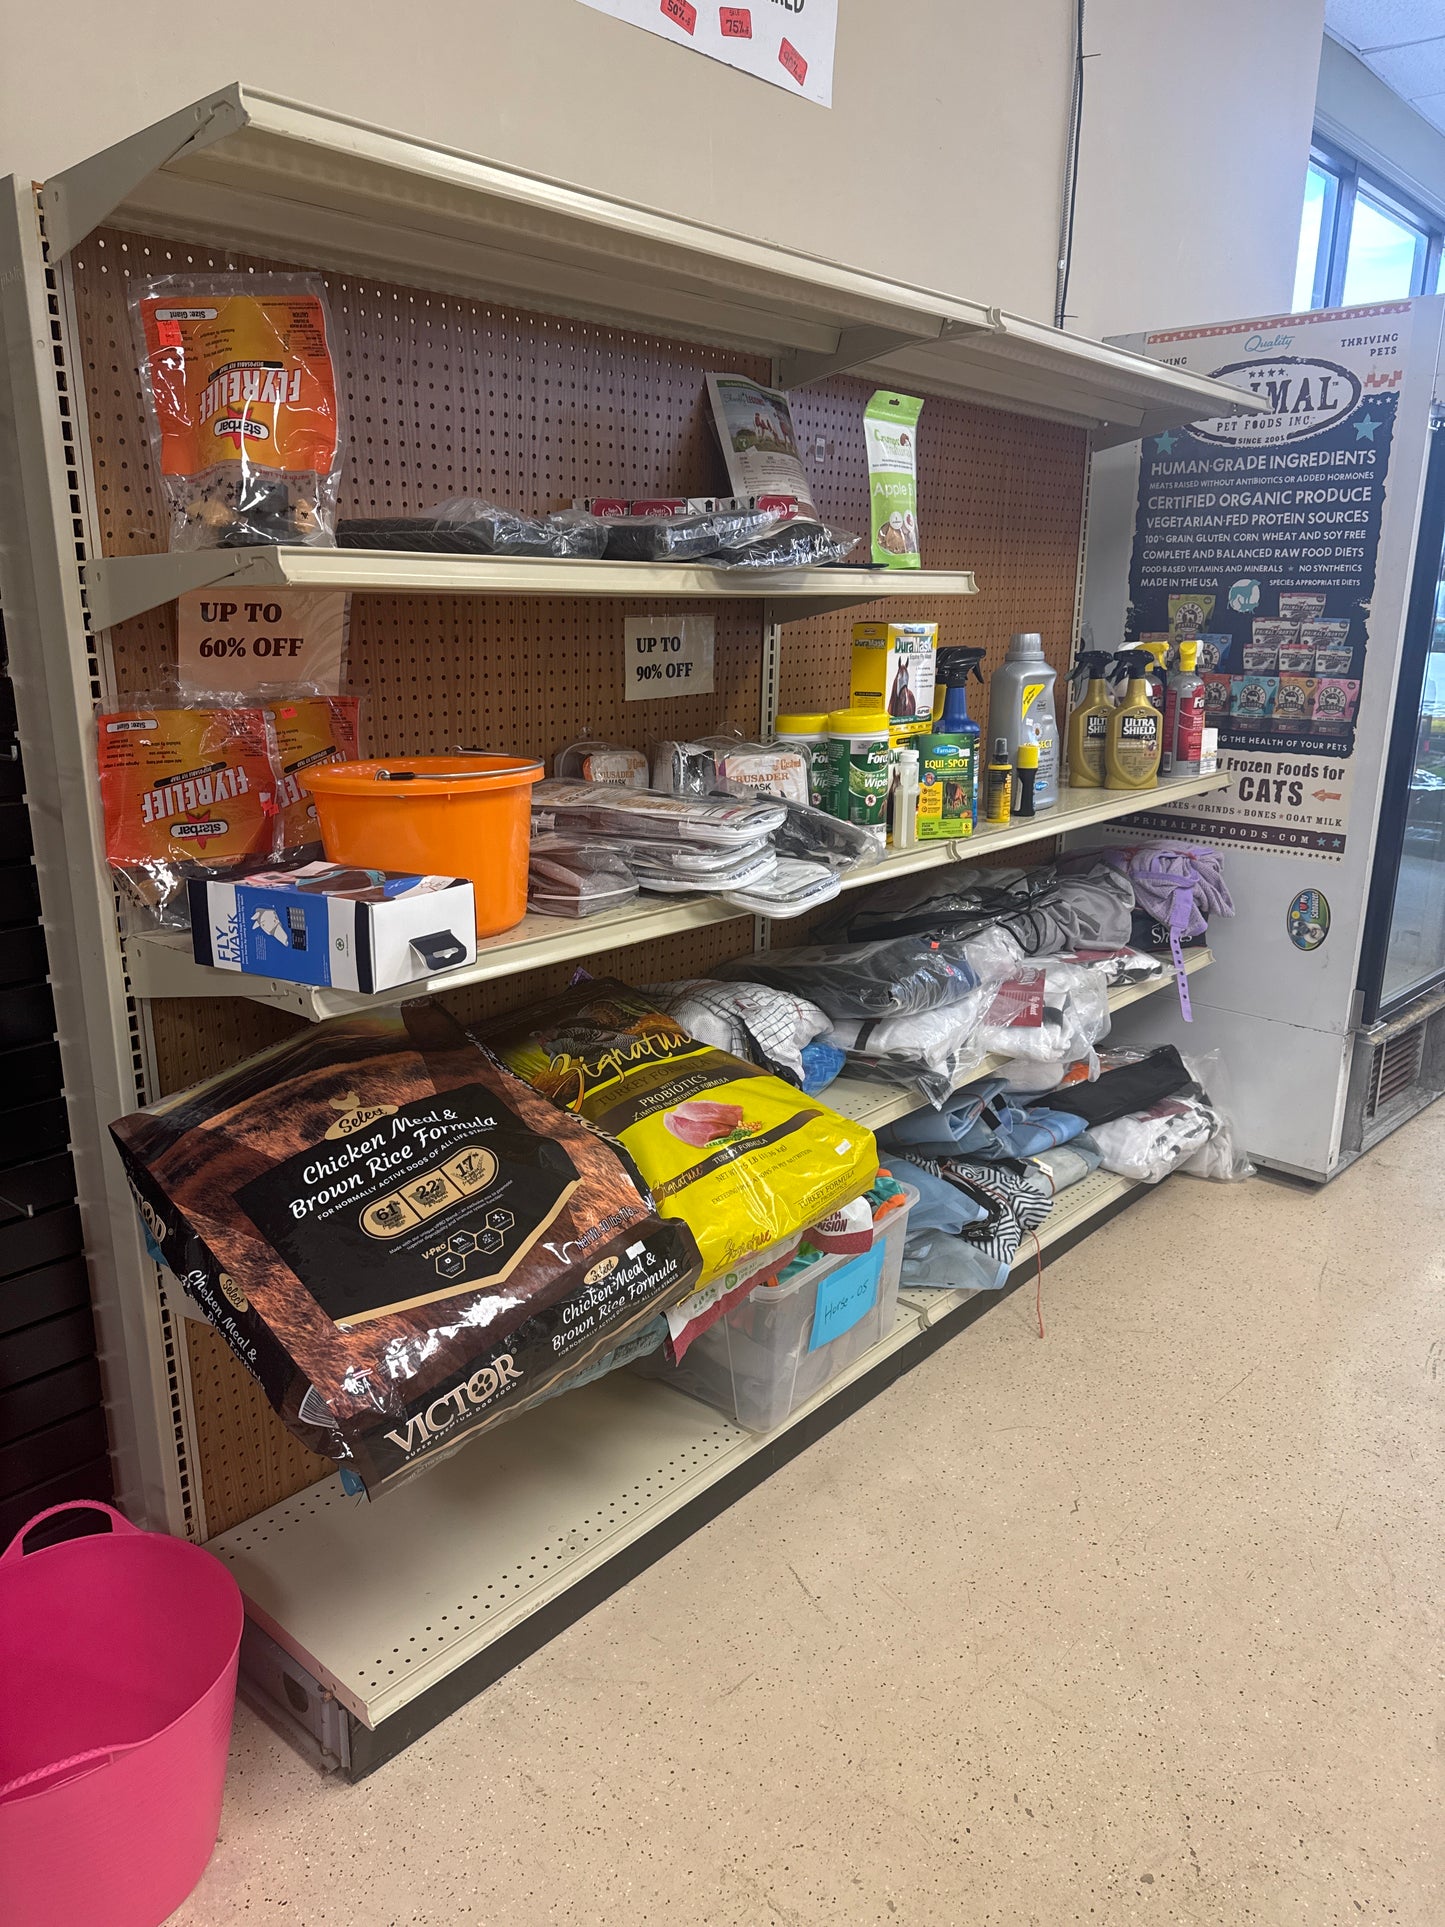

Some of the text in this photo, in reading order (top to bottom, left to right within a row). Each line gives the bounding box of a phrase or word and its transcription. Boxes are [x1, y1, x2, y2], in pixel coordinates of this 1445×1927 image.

[667, 1, 685, 21] 50%
[726, 18, 744, 34] 75%
[169, 310, 206, 319] Size: Giant
[1244, 334, 1296, 353] Quality
[1340, 332, 1399, 348] THRIVING
[1370, 346, 1398, 356] PETS
[199, 368, 302, 424] FLYRELIEF
[218, 419, 262, 436] starbar
[1216, 421, 1238, 432] PET
[1244, 418, 1282, 430] FOODS
[1264, 435, 1285, 444] 2001
[1269, 449, 1376, 470] INGREDIENTS
[874, 482, 909, 497] Apple
[1149, 482, 1174, 490] MEATS
[1174, 480, 1200, 489] RAISED
[1200, 478, 1235, 488] WITHOUT
[1236, 476, 1283, 486] ANTIBIOTICS
[1296, 474, 1326, 482] ADDED
[1327, 471, 1374, 480] HORMONES
[1148, 486, 1372, 510] CERTIFIED ORGANIC PRODUCE
[1146, 510, 1369, 528] VEGETARIAN-FED PROTEIN SOURCES
[1262, 532, 1297, 540] WHEAT
[1298, 530, 1322, 540] AND
[1323, 530, 1343, 540] SOY
[1344, 530, 1366, 540] FREE
[1142, 546, 1364, 560] COMPLETE AND BALANCED RAW FOOD DIETS
[1187, 564, 1224, 573] VITAMINS
[1224, 564, 1243, 572] AND
[1244, 564, 1284, 572] MINERALS
[1298, 564, 1362, 572] NO SYNTHETICS
[1140, 578, 1219, 587] MADE IN THE USA
[200, 602, 282, 623] UP TO
[200, 637, 304, 658] 60% OFF
[636, 636, 681, 654] UP TO
[894, 636, 933, 654] DuraMask
[636, 662, 694, 682] 90% OFF
[1122, 726, 1156, 735] SHIELD
[1124, 718, 1155, 727] ULTRA
[1230, 736, 1246, 744] THE
[1248, 736, 1284, 747] HEALTH
[1286, 740, 1298, 748] OF
[1300, 741, 1324, 750] YOUR
[1326, 742, 1348, 752] PETS
[729, 772, 790, 784] CRUSADER
[1226, 757, 1272, 774] Frozen
[1276, 762, 1320, 779] Foods
[1322, 766, 1345, 781] for
[141, 766, 250, 824] FLYRELIEF
[1238, 776, 1304, 806] CATS
[1198, 804, 1343, 828] GRINDS BONES GOAT MILK
[178, 822, 221, 836] starbar
[216, 926, 231, 962] FLY
[227, 914, 242, 963] MASK
[598, 1057, 712, 1107] TURKEY FORMULA
[638, 1074, 708, 1107] PROBIOTICS
[660, 1080, 675, 1090] WITH
[631, 1076, 730, 1122] LIMITED INGREDIENT FORMULA
[338, 1108, 388, 1134] Select
[302, 1109, 458, 1185] Chicken Meal &
[738, 1138, 768, 1154] FORMULA
[288, 1174, 364, 1220] Brown
[366, 1145, 414, 1179] Rice
[412, 1116, 498, 1149] Formula
[317, 1132, 470, 1220] FOR NORMALLY ACTIVE DOGS OF ALL LIFE
[715, 1170, 730, 1182] NET
[749, 1156, 760, 1167] LB
[798, 1170, 856, 1210] TURKEY FORMULA
[576, 1234, 590, 1250] Net
[609, 1213, 622, 1230] lbs
[421, 1242, 448, 1260] V-PRO
[222, 1278, 246, 1308] Select
[562, 1252, 657, 1325] Chicken Meal &
[551, 1258, 678, 1352] Brown Rice Formula
[824, 1296, 848, 1327] Horse
[221, 1316, 250, 1352] Meal
[246, 1348, 257, 1364] &
[383, 1353, 524, 1452] VICTOR
[405, 1382, 517, 1460] SUPER PREMIUM DOG FOOD
